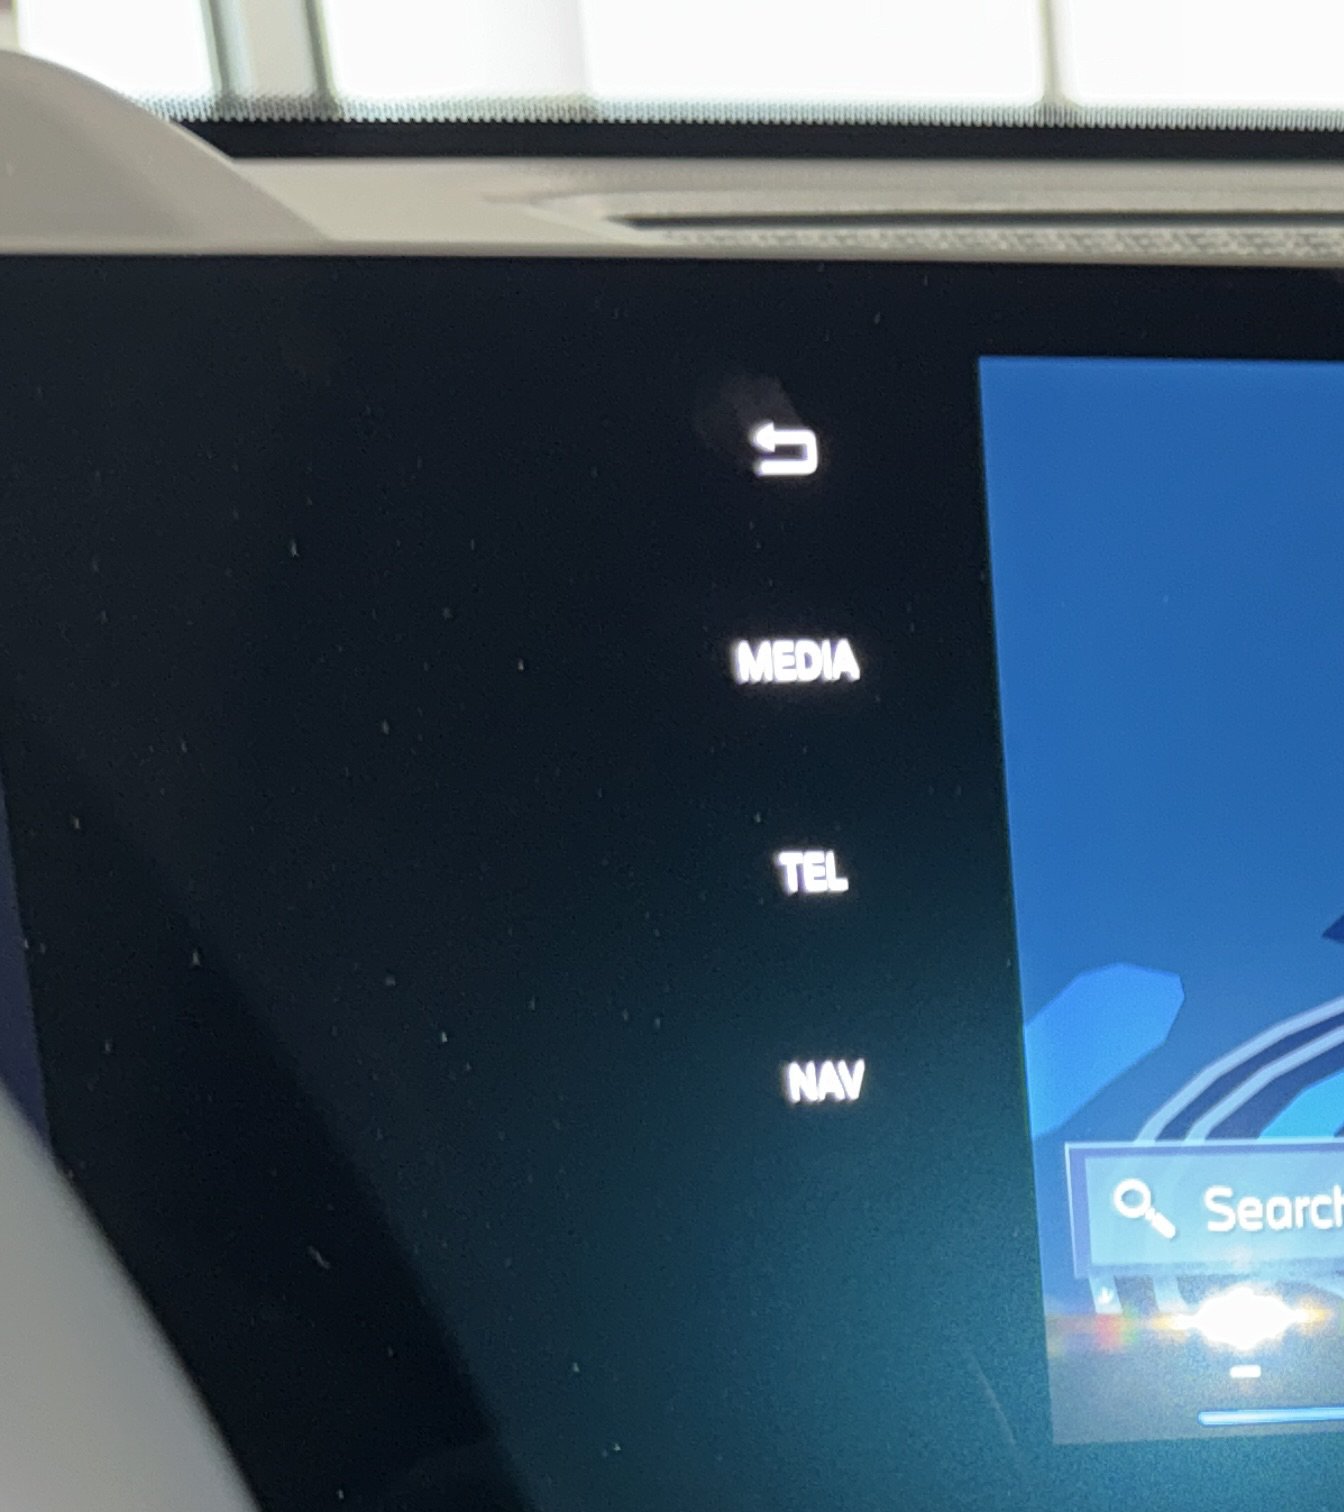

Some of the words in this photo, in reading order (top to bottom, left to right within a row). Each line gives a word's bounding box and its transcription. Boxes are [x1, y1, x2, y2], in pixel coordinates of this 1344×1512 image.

[733, 638, 861, 684] MEDIA
[776, 850, 849, 895] TEL
[786, 1058, 865, 1104] NAV
